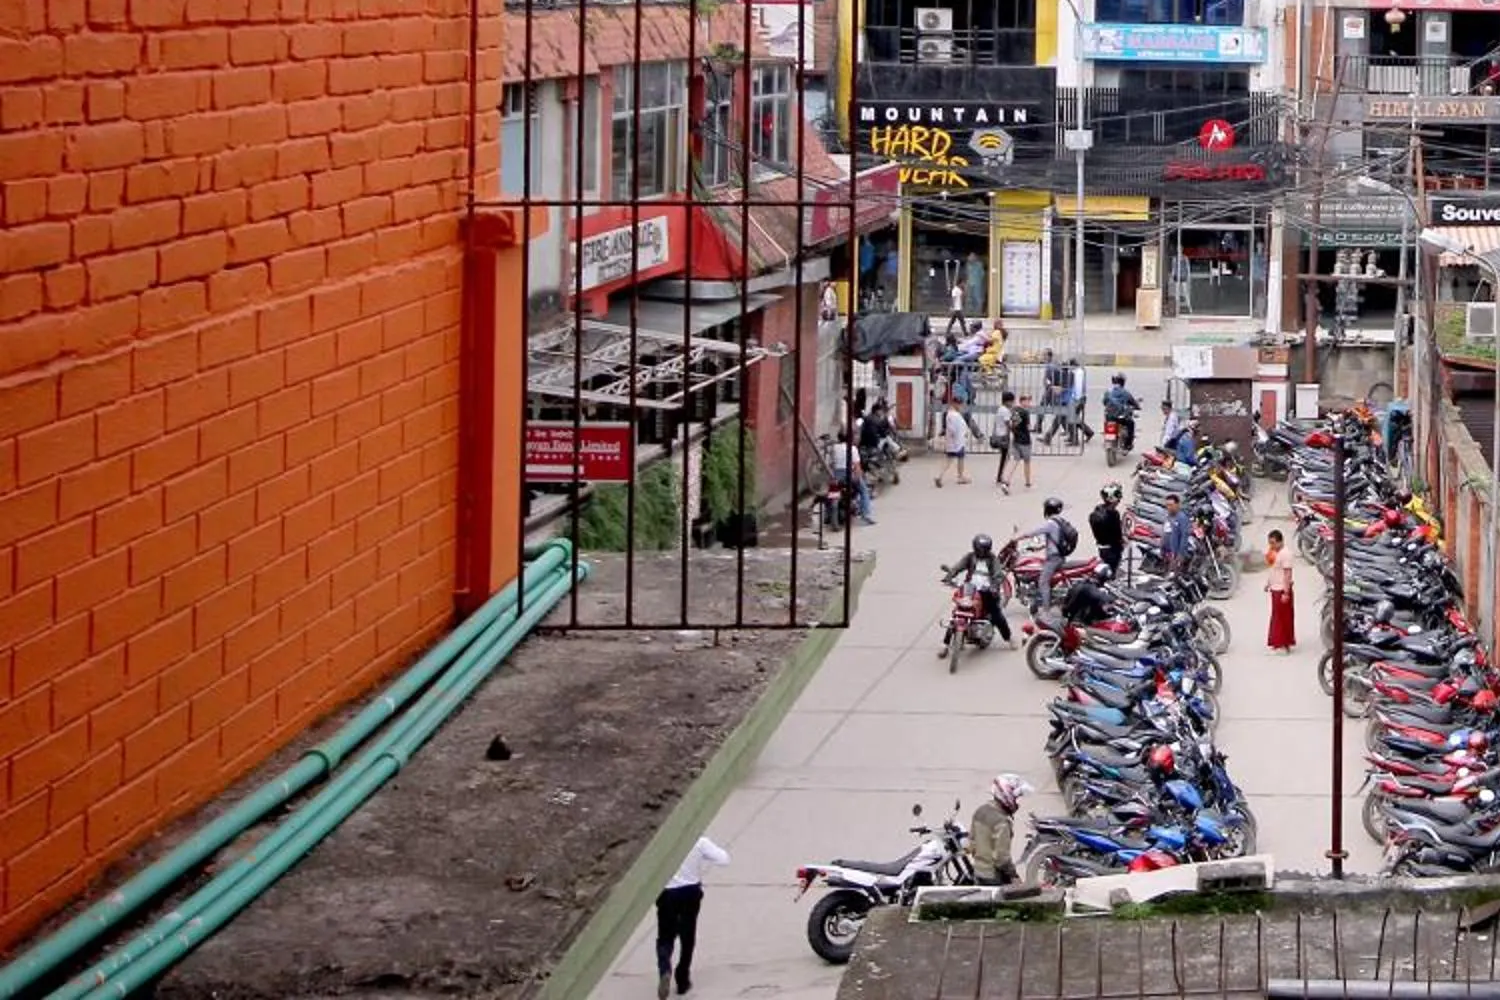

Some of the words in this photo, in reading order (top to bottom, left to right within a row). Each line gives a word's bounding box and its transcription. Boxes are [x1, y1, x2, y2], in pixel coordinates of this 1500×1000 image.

[861, 106, 1027, 122] MOUNTAIN
[1369, 101, 1487, 117] HIMALAYAN
[871, 124, 952, 161] HARD
[583, 235, 609, 263] FIRE
